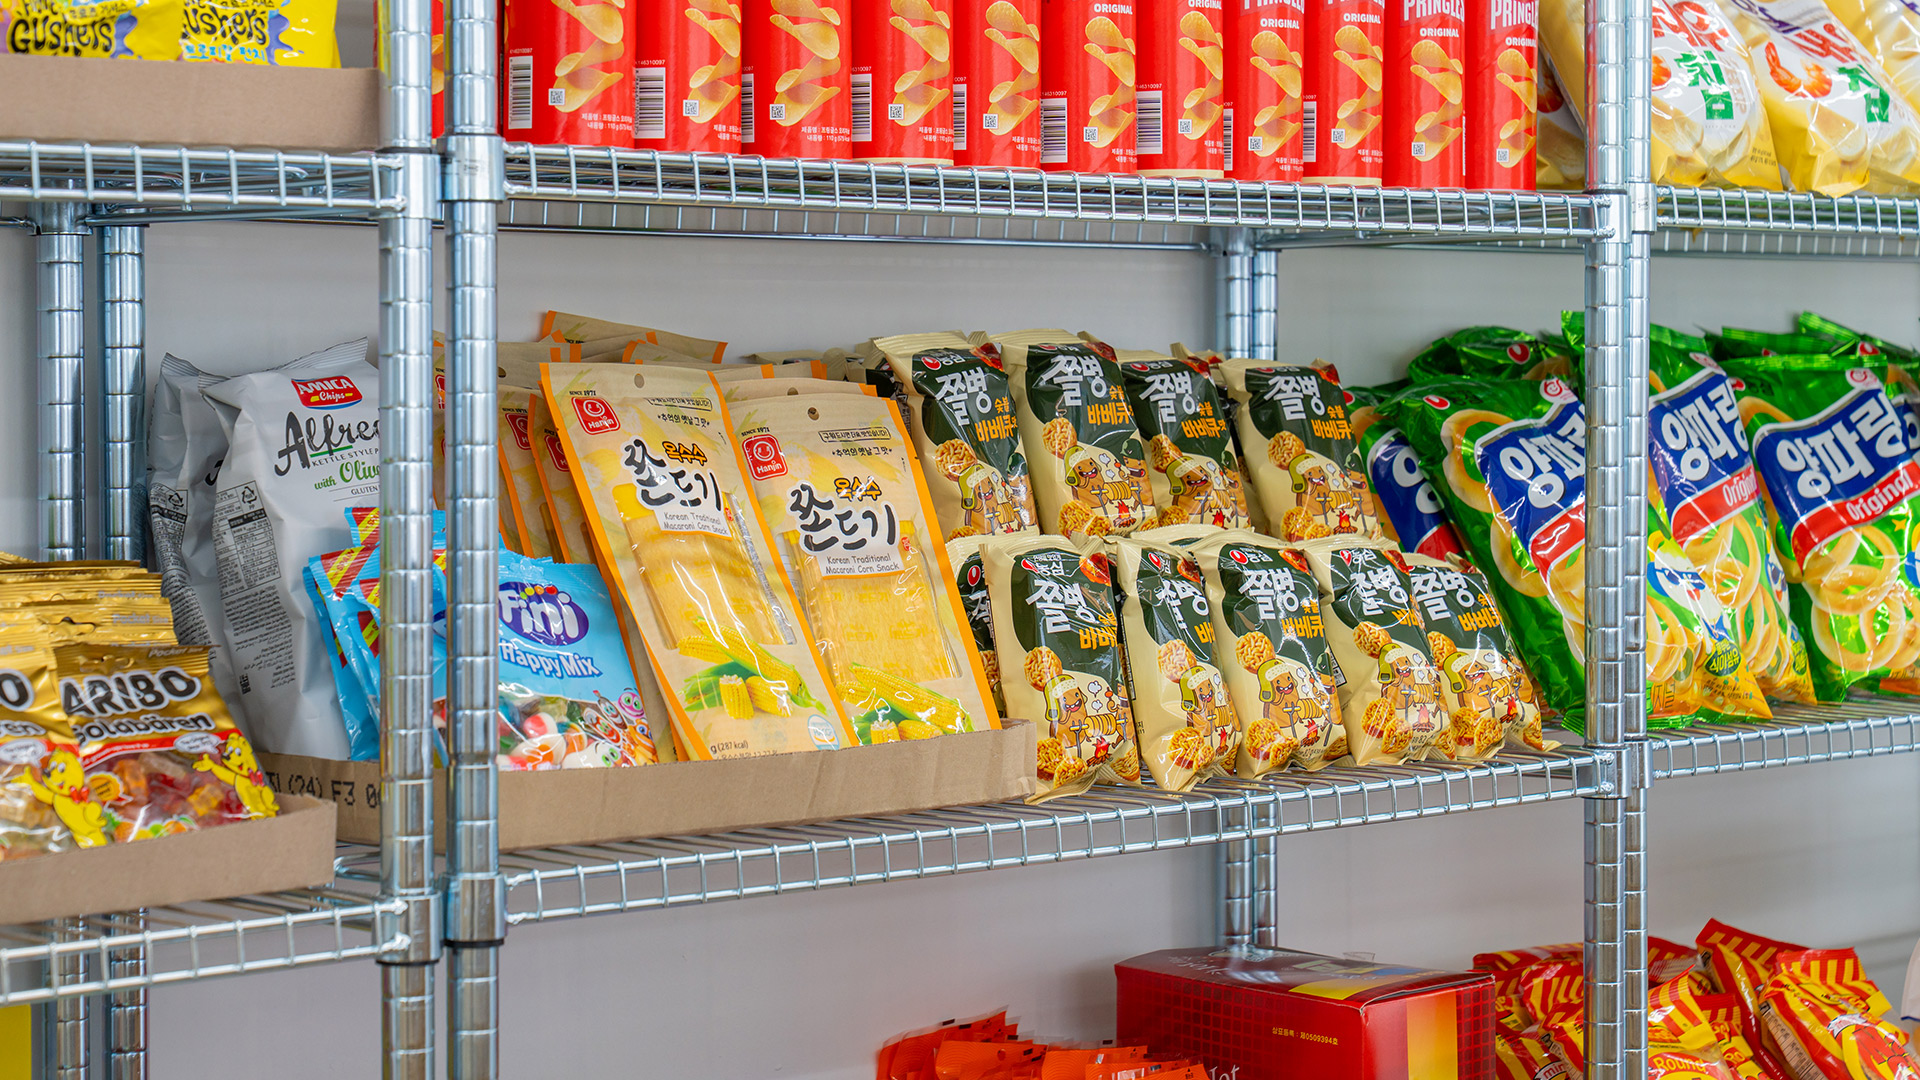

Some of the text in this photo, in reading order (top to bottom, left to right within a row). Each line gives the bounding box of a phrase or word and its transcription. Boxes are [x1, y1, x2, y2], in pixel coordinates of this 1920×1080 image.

[1094, 3, 1133, 15] ORIGINAL
[1260, 18, 1299, 29] ORIGINAL
[1343, 12, 1381, 24] ORIGINAL
[1420, 27, 1459, 38] ORIGINAL
[296, 378, 354, 395] AMICA
[1041, 355, 1107, 406] 쫄병
[319, 391, 346, 402] Chips
[935, 366, 992, 426] 쫄병
[1139, 370, 1195, 422] 쫄병
[1264, 375, 1325, 420] 쫄병
[1661, 379, 1749, 481] 양파링
[1776, 392, 1907, 498] 양파링
[347, 447, 373, 459] STYLE
[662, 441, 707, 466] 옥수수
[312, 455, 347, 467] KETTLE
[756, 460, 782, 474] Hanjin
[314, 475, 338, 490] with
[834, 476, 882, 501] 옥수수
[351, 486, 378, 495] GLUTEN
[1846, 469, 1914, 522] Original
[664, 512, 689, 520] Korean
[790, 484, 896, 551] 쫀드기
[663, 522, 695, 530] Macaroni
[697, 522, 711, 531] Corn
[827, 553, 891, 565] Korean Traditional
[825, 563, 899, 574] Macaroni Corn Snack
[1035, 560, 1064, 575] 농심
[1238, 567, 1299, 619] 쫄병
[498, 589, 579, 638] Fini
[1026, 579, 1099, 634] 쫄병
[710, 745, 717, 754] g
[331, 780, 355, 806] F3
[1272, 1026, 1294, 1038] 상표등록
